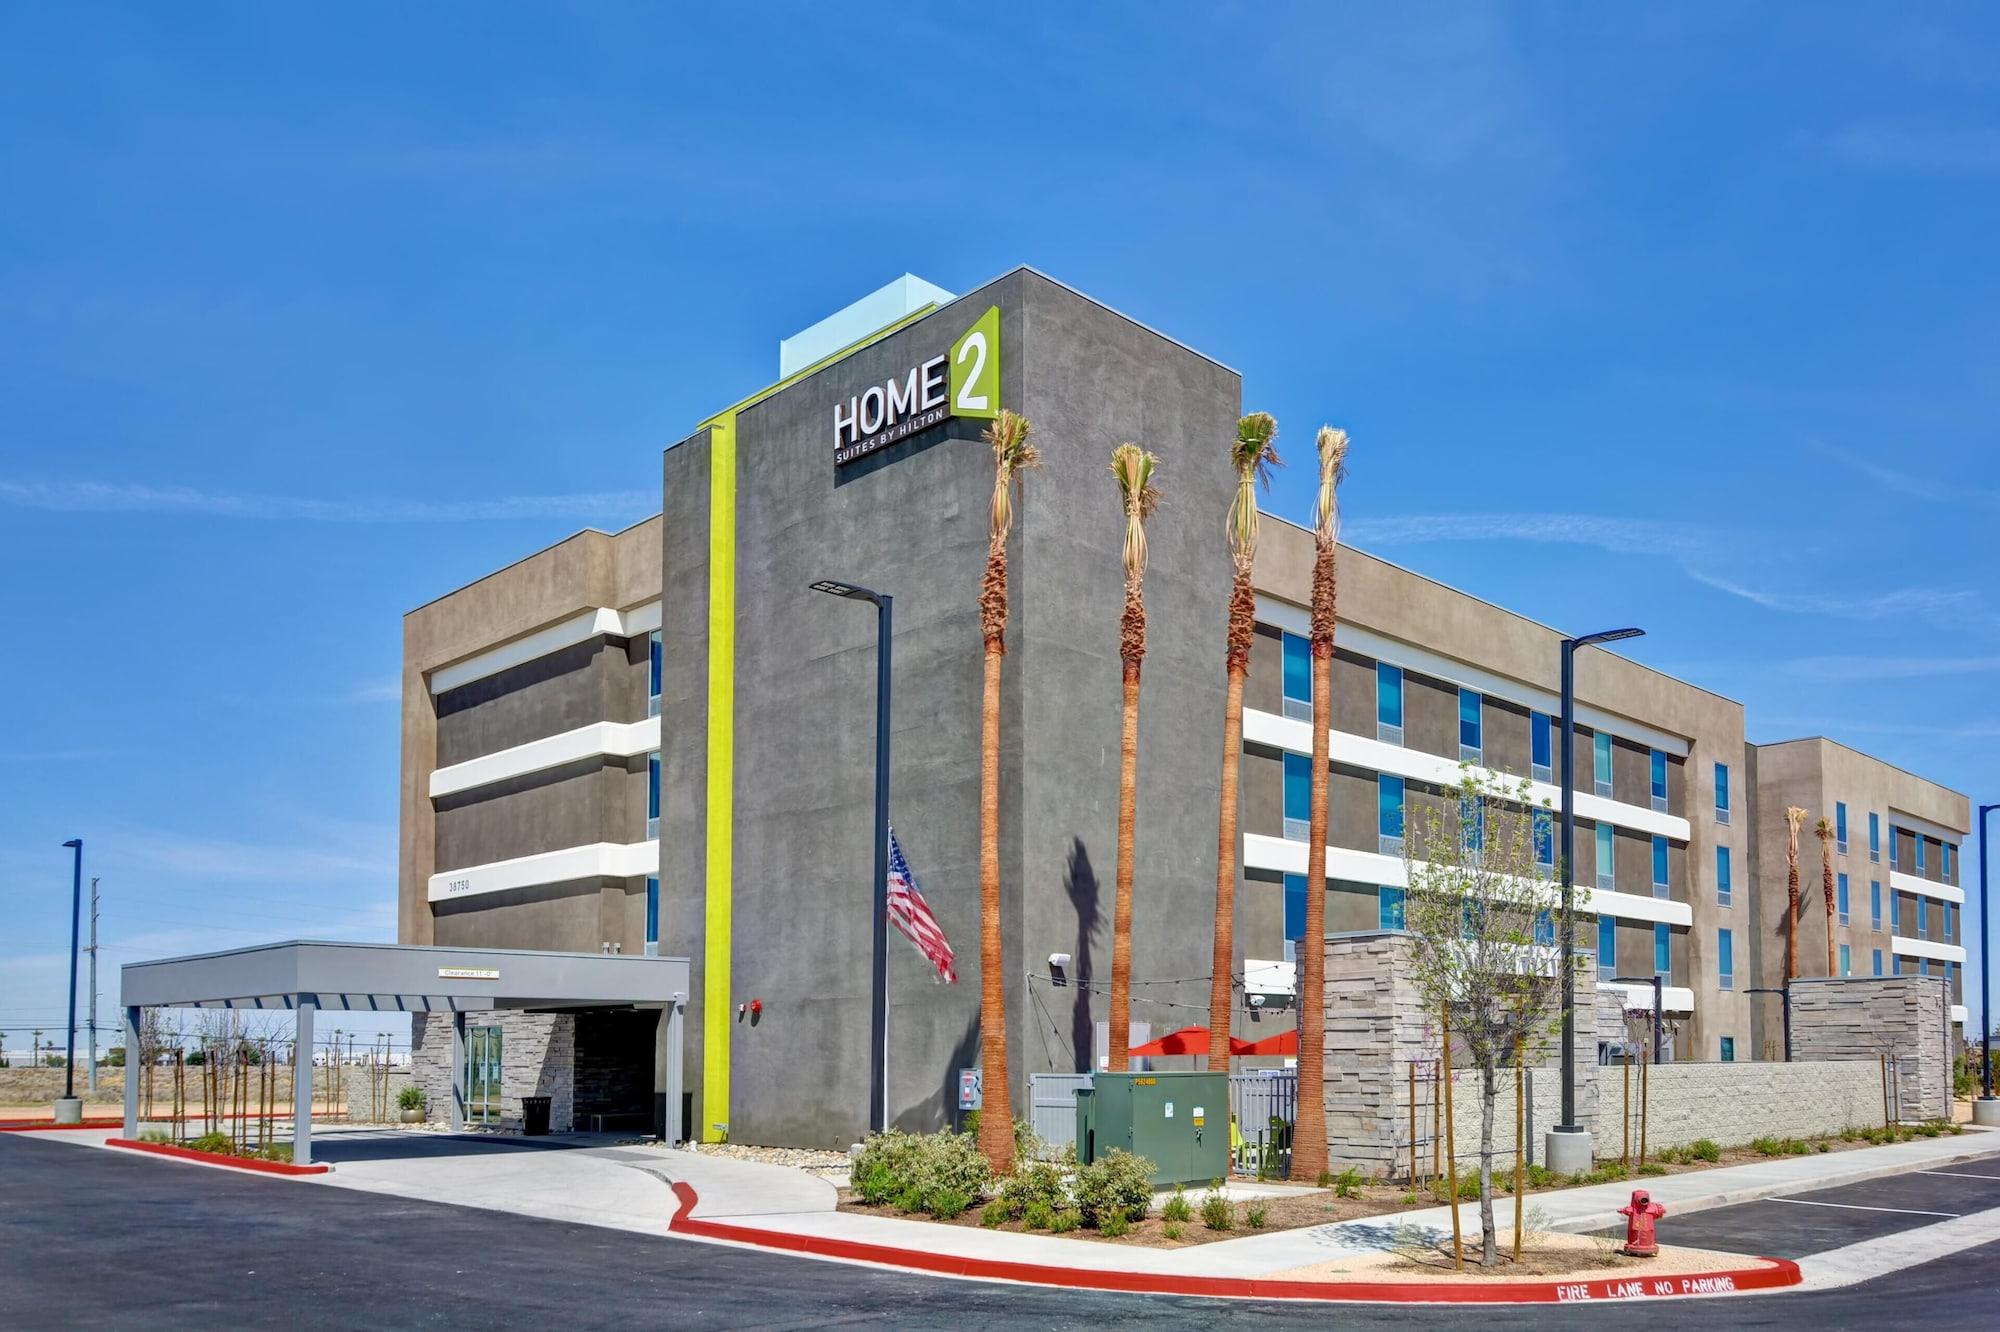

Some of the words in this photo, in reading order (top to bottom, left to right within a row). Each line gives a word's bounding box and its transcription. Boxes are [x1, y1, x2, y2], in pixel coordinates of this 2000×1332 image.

[834, 354, 949, 450] HOME
[957, 331, 988, 410] 2
[836, 441, 876, 463] SUITES
[880, 430, 894, 443] BY
[899, 409, 944, 435] HILTON
[1557, 1285, 1590, 1300] FIRE
[1607, 1281, 1643, 1298] LANE
[1655, 1281, 1673, 1295] NO
[1682, 1276, 1735, 1293] PARKING
